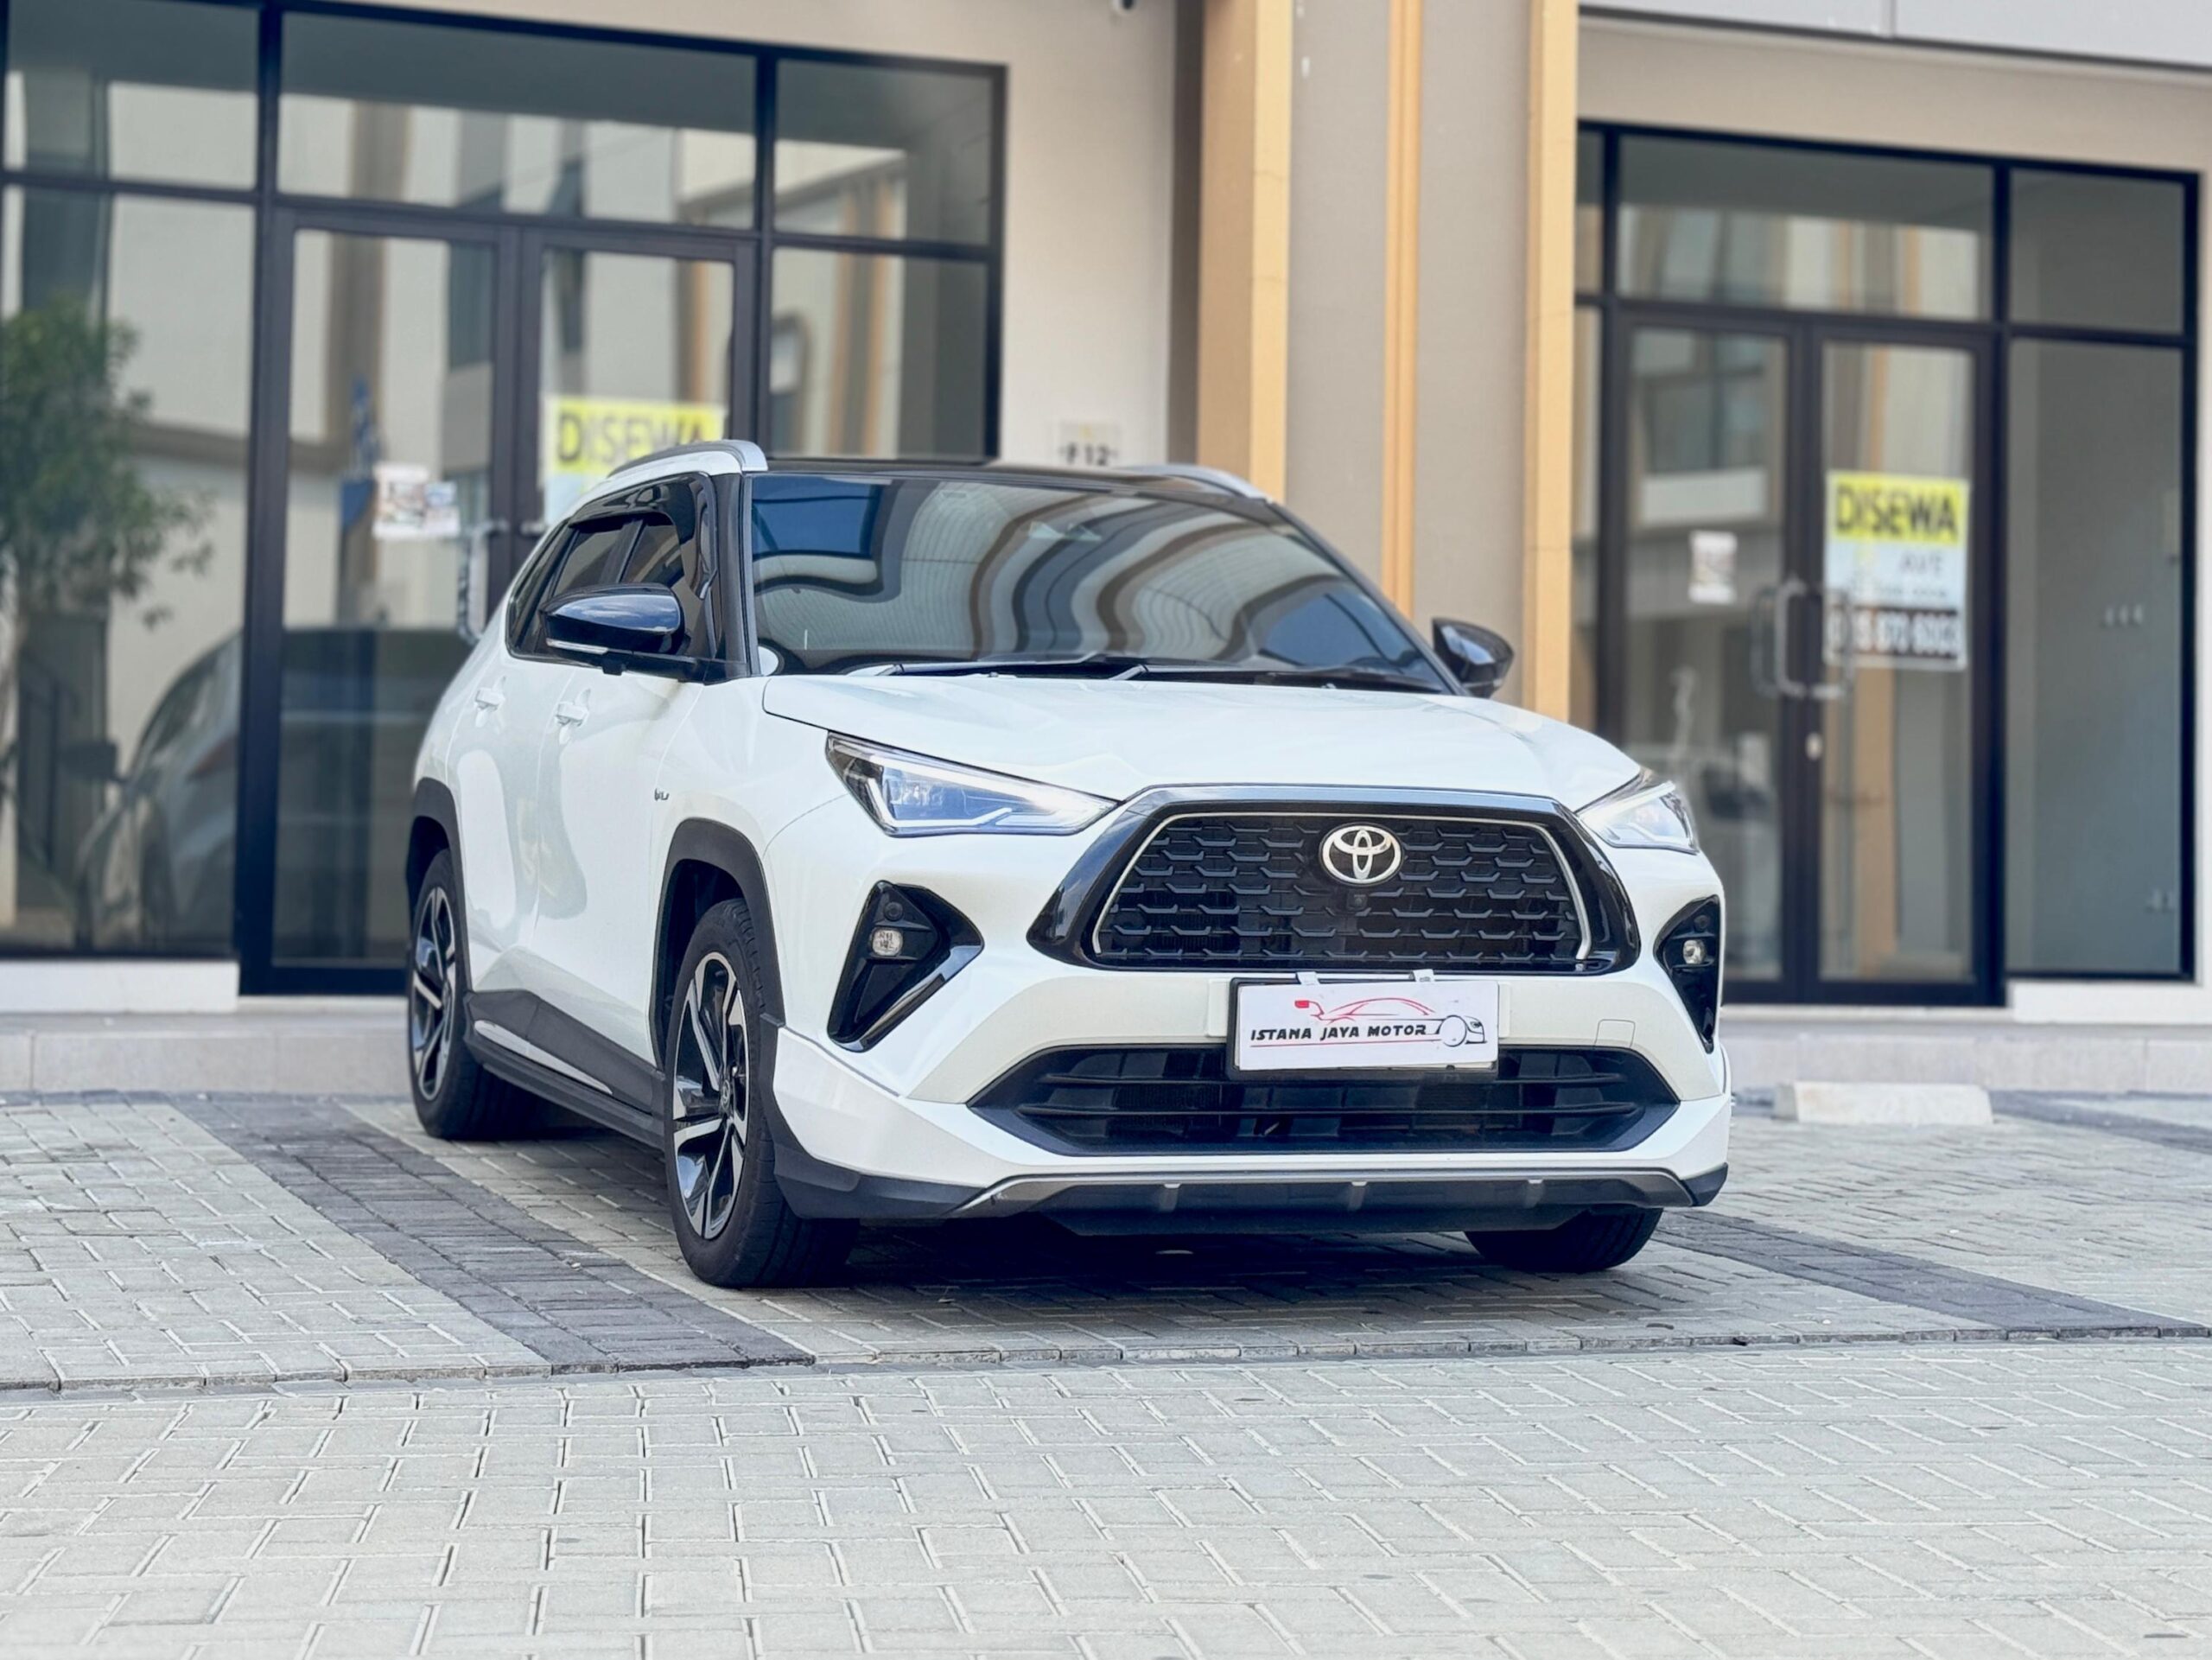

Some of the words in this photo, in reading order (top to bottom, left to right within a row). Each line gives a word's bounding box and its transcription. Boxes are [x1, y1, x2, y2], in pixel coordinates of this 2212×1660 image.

[1835, 483, 1959, 540] DISEWA
[1250, 1027, 1312, 1041] ISTANA
[1319, 1026, 1360, 1041] JAYA
[1367, 1023, 1427, 1038] MOTOR
